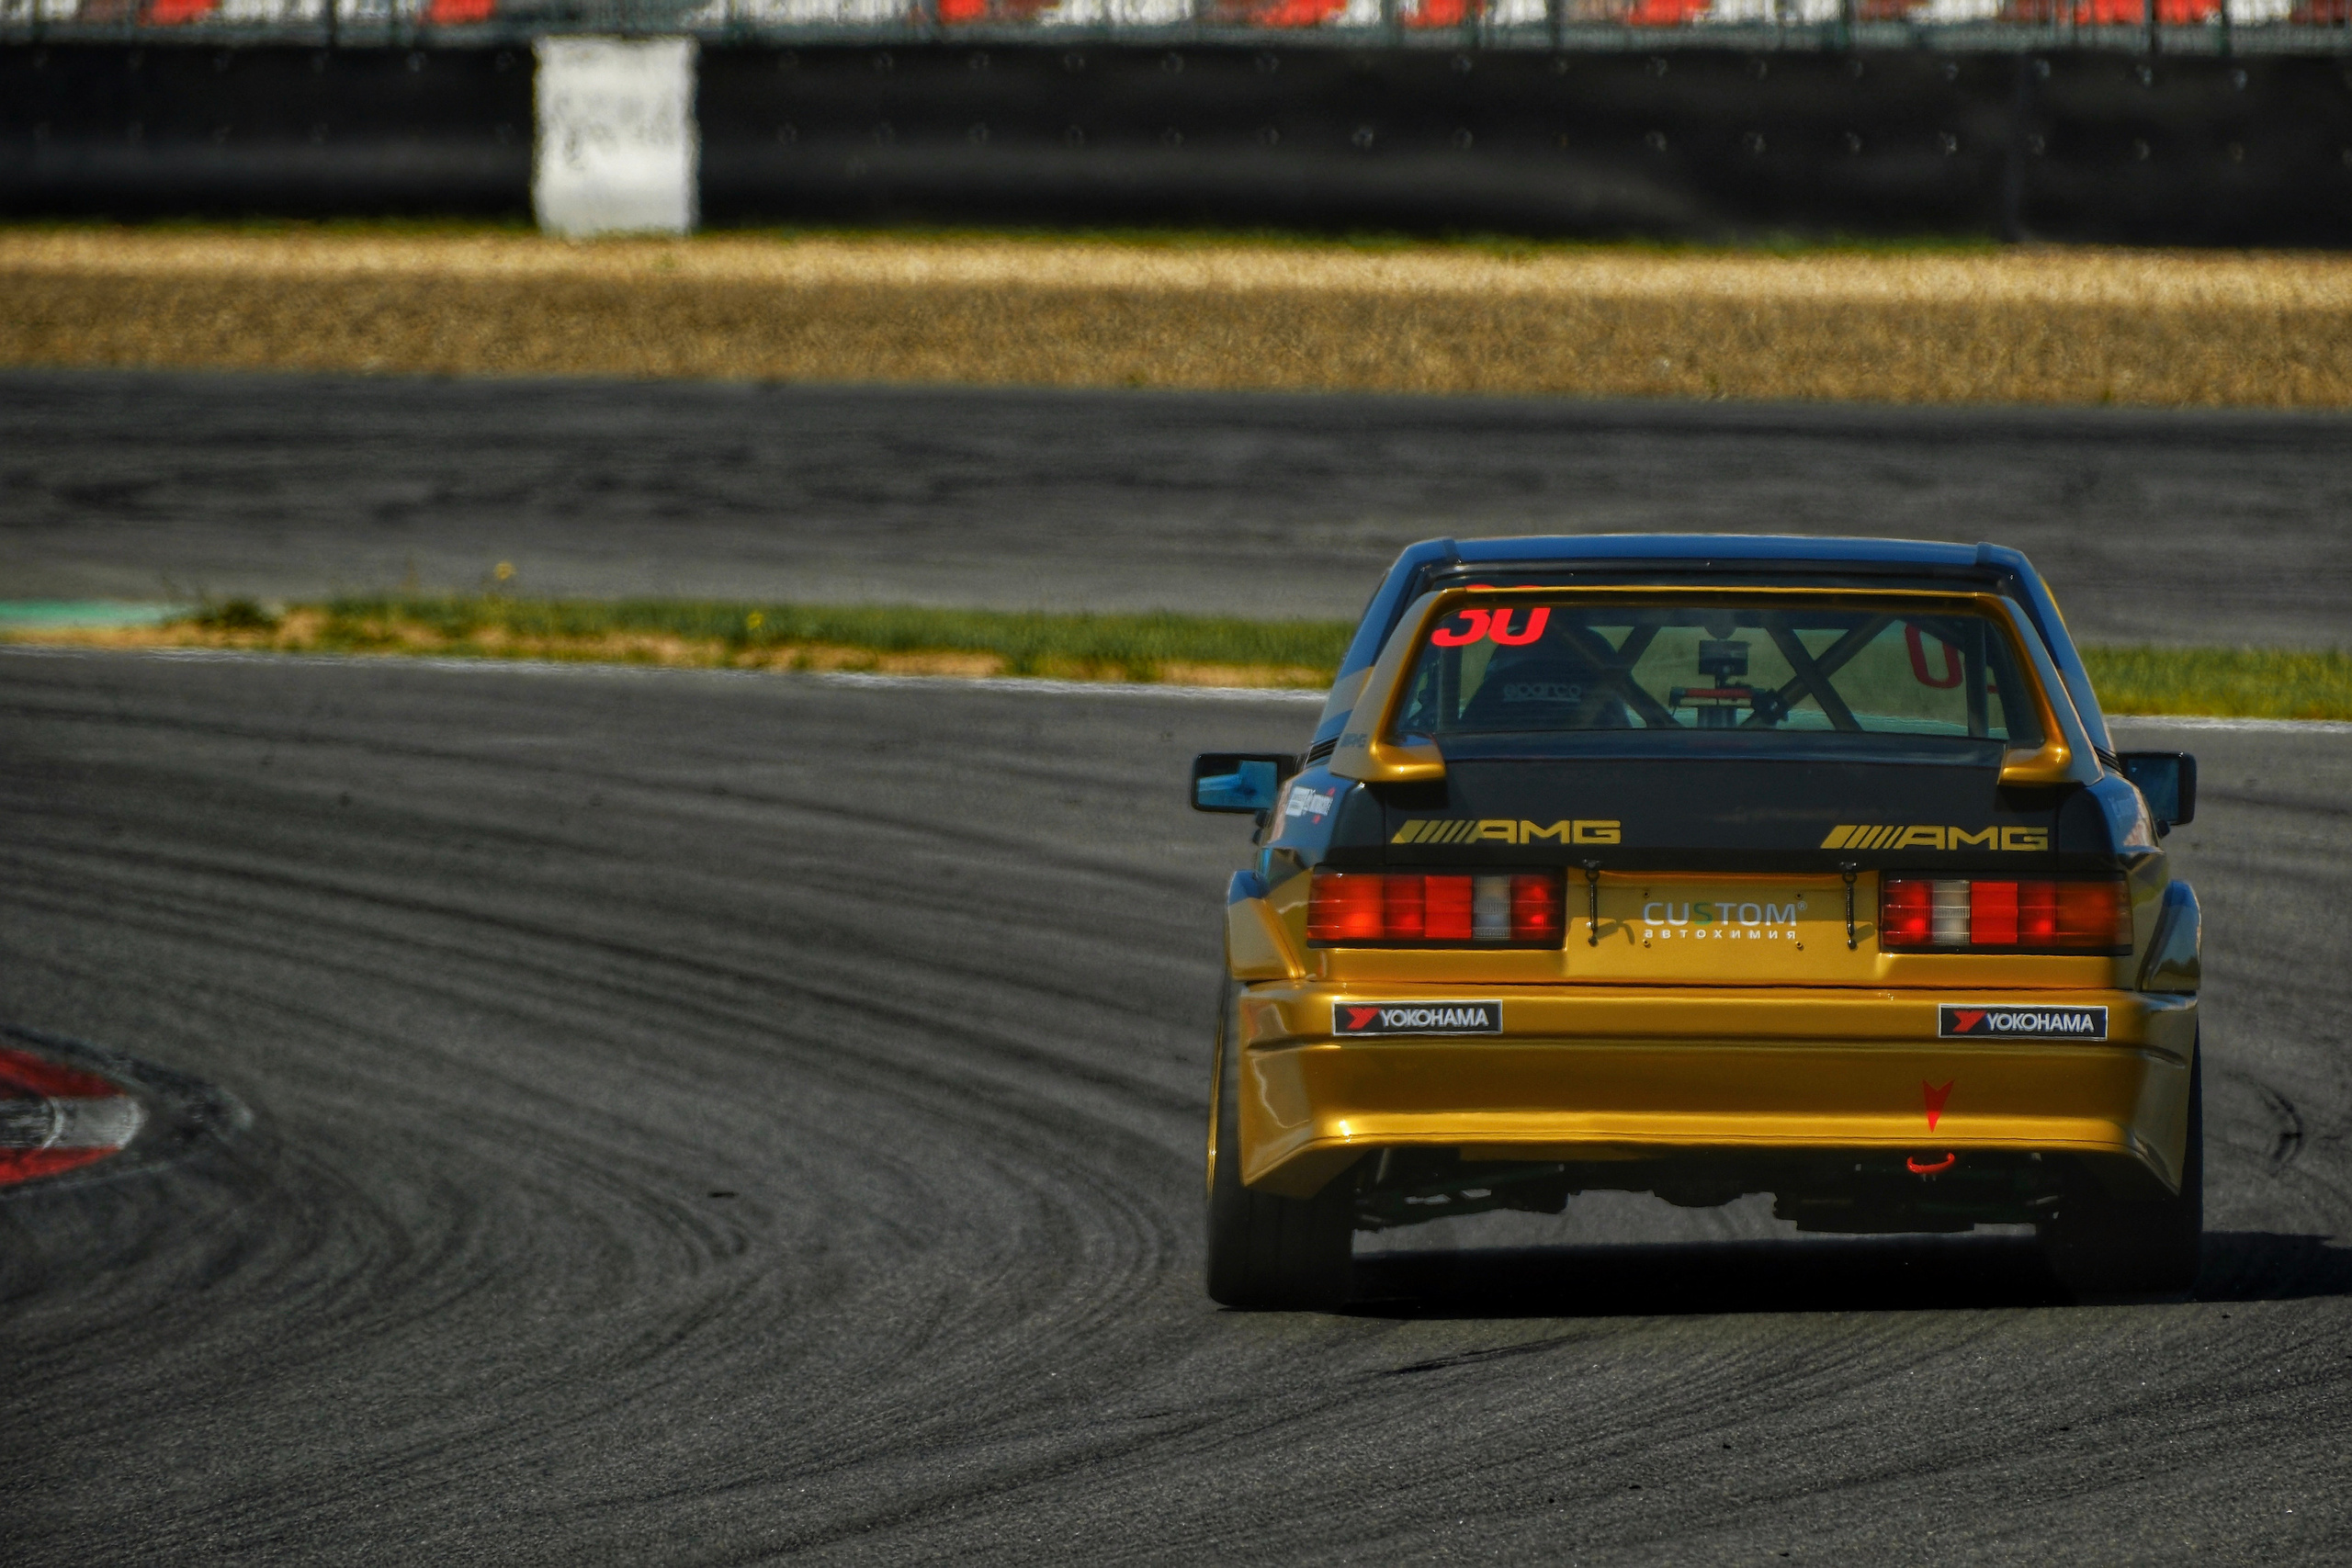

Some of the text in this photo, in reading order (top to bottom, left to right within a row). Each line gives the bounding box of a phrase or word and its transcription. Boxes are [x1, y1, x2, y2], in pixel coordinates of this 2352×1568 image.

[1431, 585, 1551, 647] 30
[1464, 819, 1622, 844] AMG
[1893, 825, 2049, 851] AMG
[1645, 929, 1796, 940] автохимия
[1381, 1008, 1489, 1027] YOKOHAMA
[1985, 1012, 2095, 1032] YOKOHAMA
